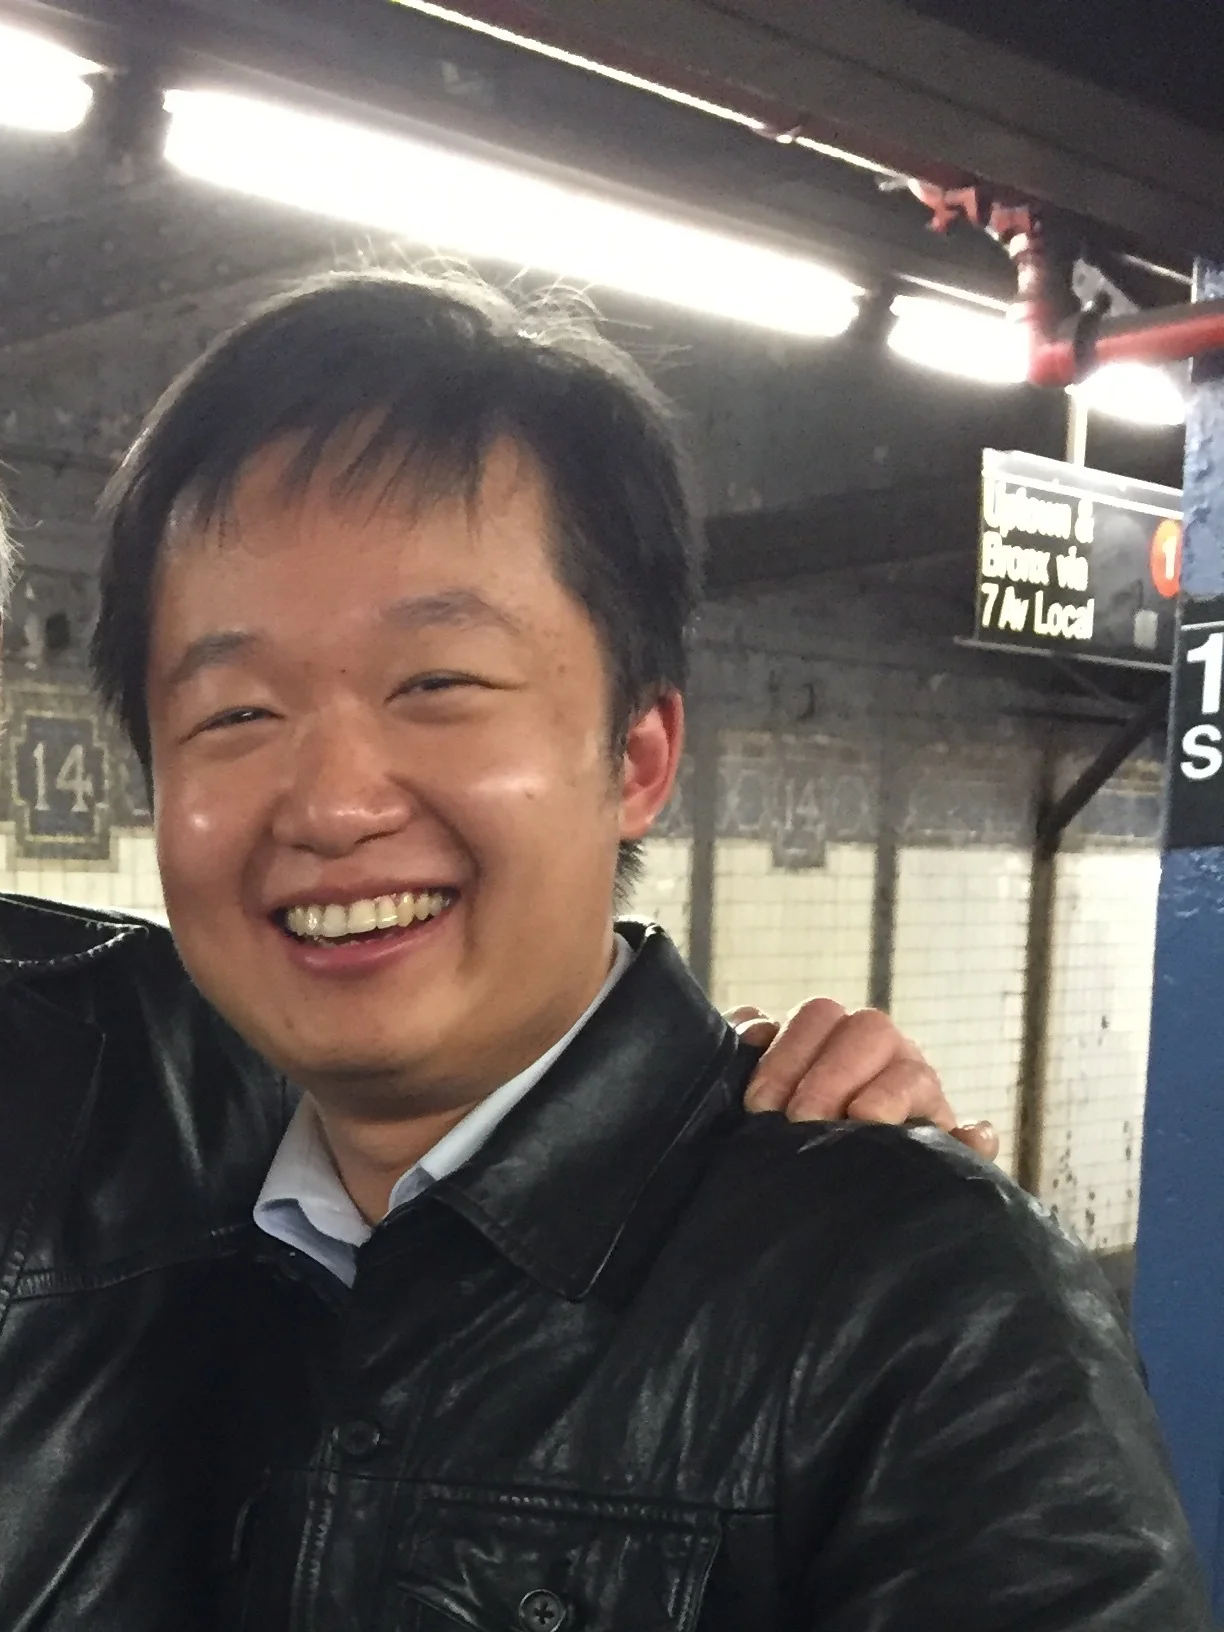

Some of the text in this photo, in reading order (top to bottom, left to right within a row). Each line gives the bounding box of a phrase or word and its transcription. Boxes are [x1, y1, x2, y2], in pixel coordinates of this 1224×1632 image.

[984, 480, 1095, 544] Uptown &
[982, 532, 1090, 592] Bronx via
[1161, 535, 1178, 581] 1
[981, 583, 1096, 641] 7 Av Local
[33, 741, 95, 812] 14
